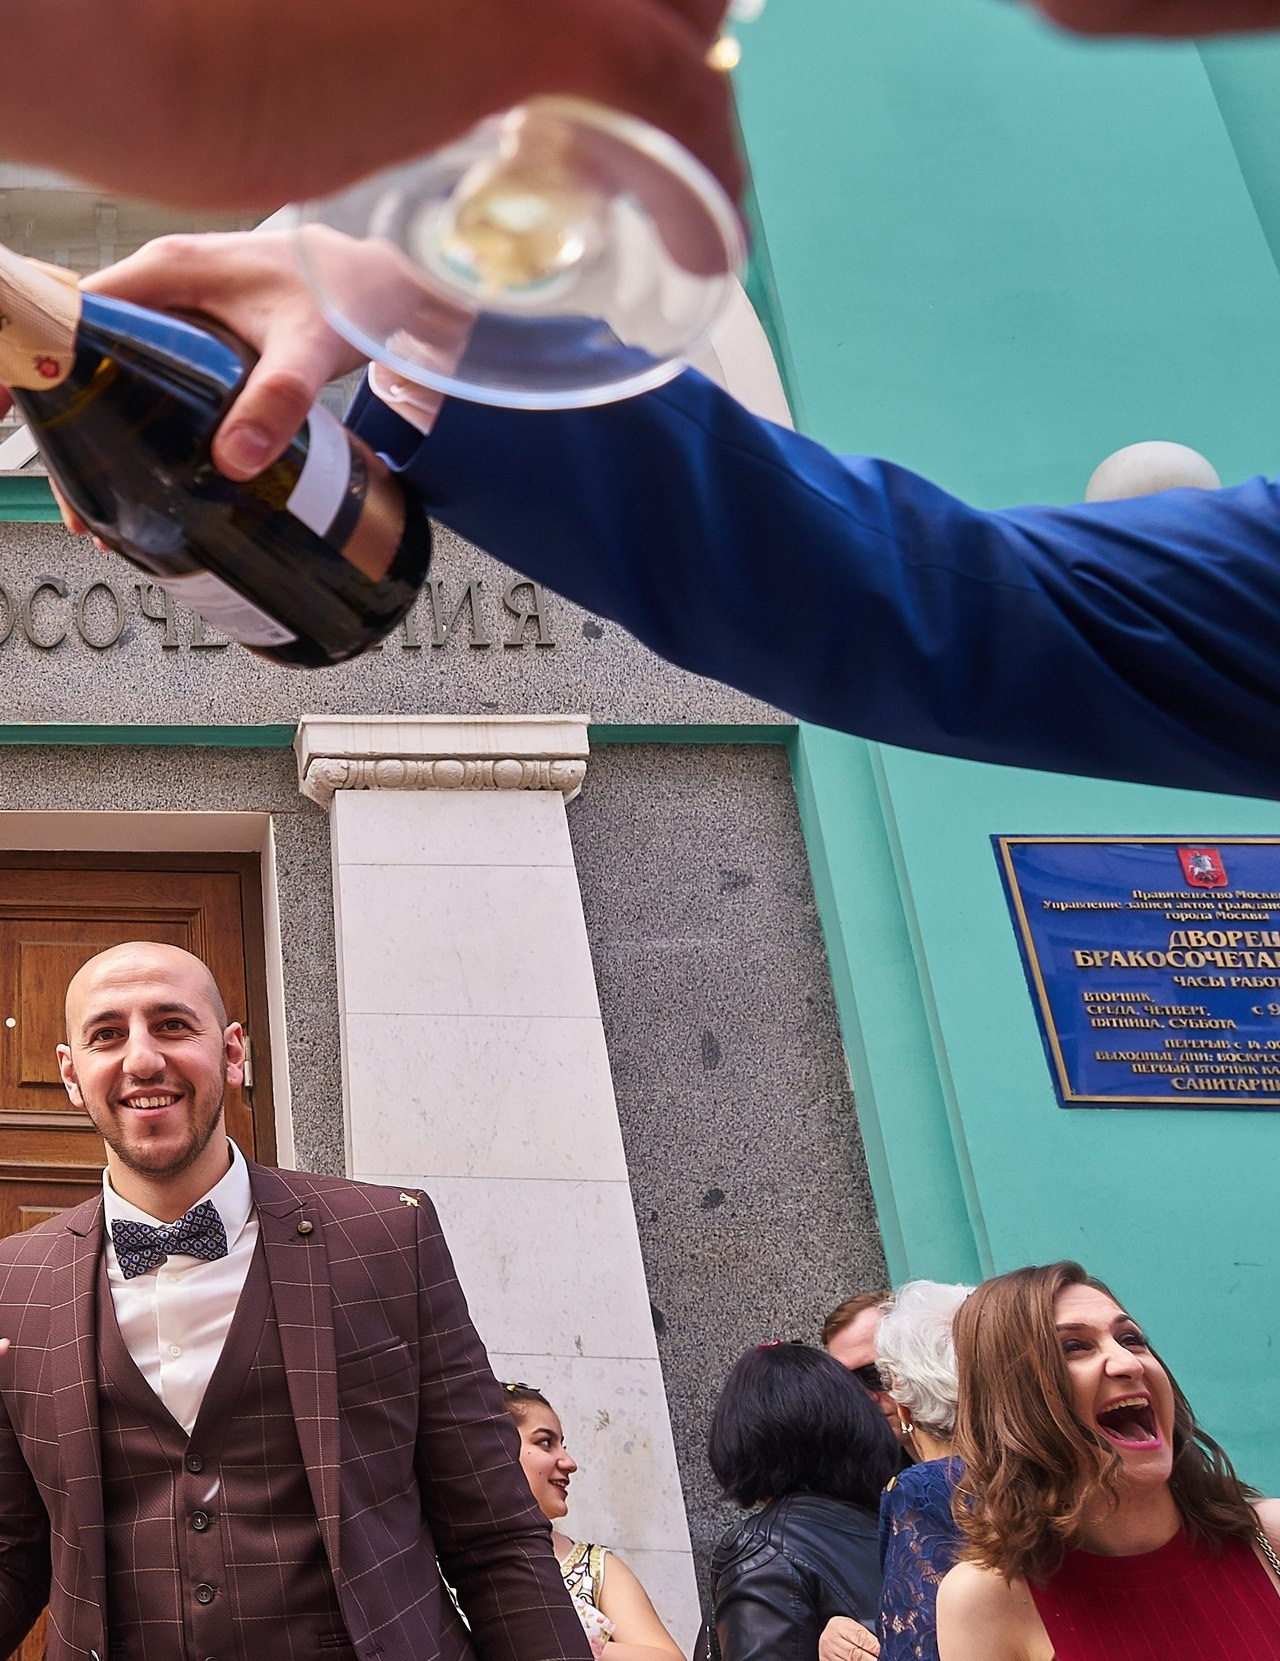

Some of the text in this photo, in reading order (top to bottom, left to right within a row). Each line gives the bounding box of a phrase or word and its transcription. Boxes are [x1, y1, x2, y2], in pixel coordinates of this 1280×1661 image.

[1235, 890, 1280, 899] Москв
[1166, 911, 1270, 921] города Москвы
[1173, 976, 1227, 988] ЧАСЫ
[1168, 1018, 1238, 1029] СУББОТА
[1165, 1040, 1231, 1049] ПЕРЕРЫВ
[1095, 1051, 1176, 1062] ВЫХОДНЫЕ
[1132, 1062, 1190, 1073] ПЕРВЫЙ
[1195, 1065, 1259, 1074] ВТОРНИК
